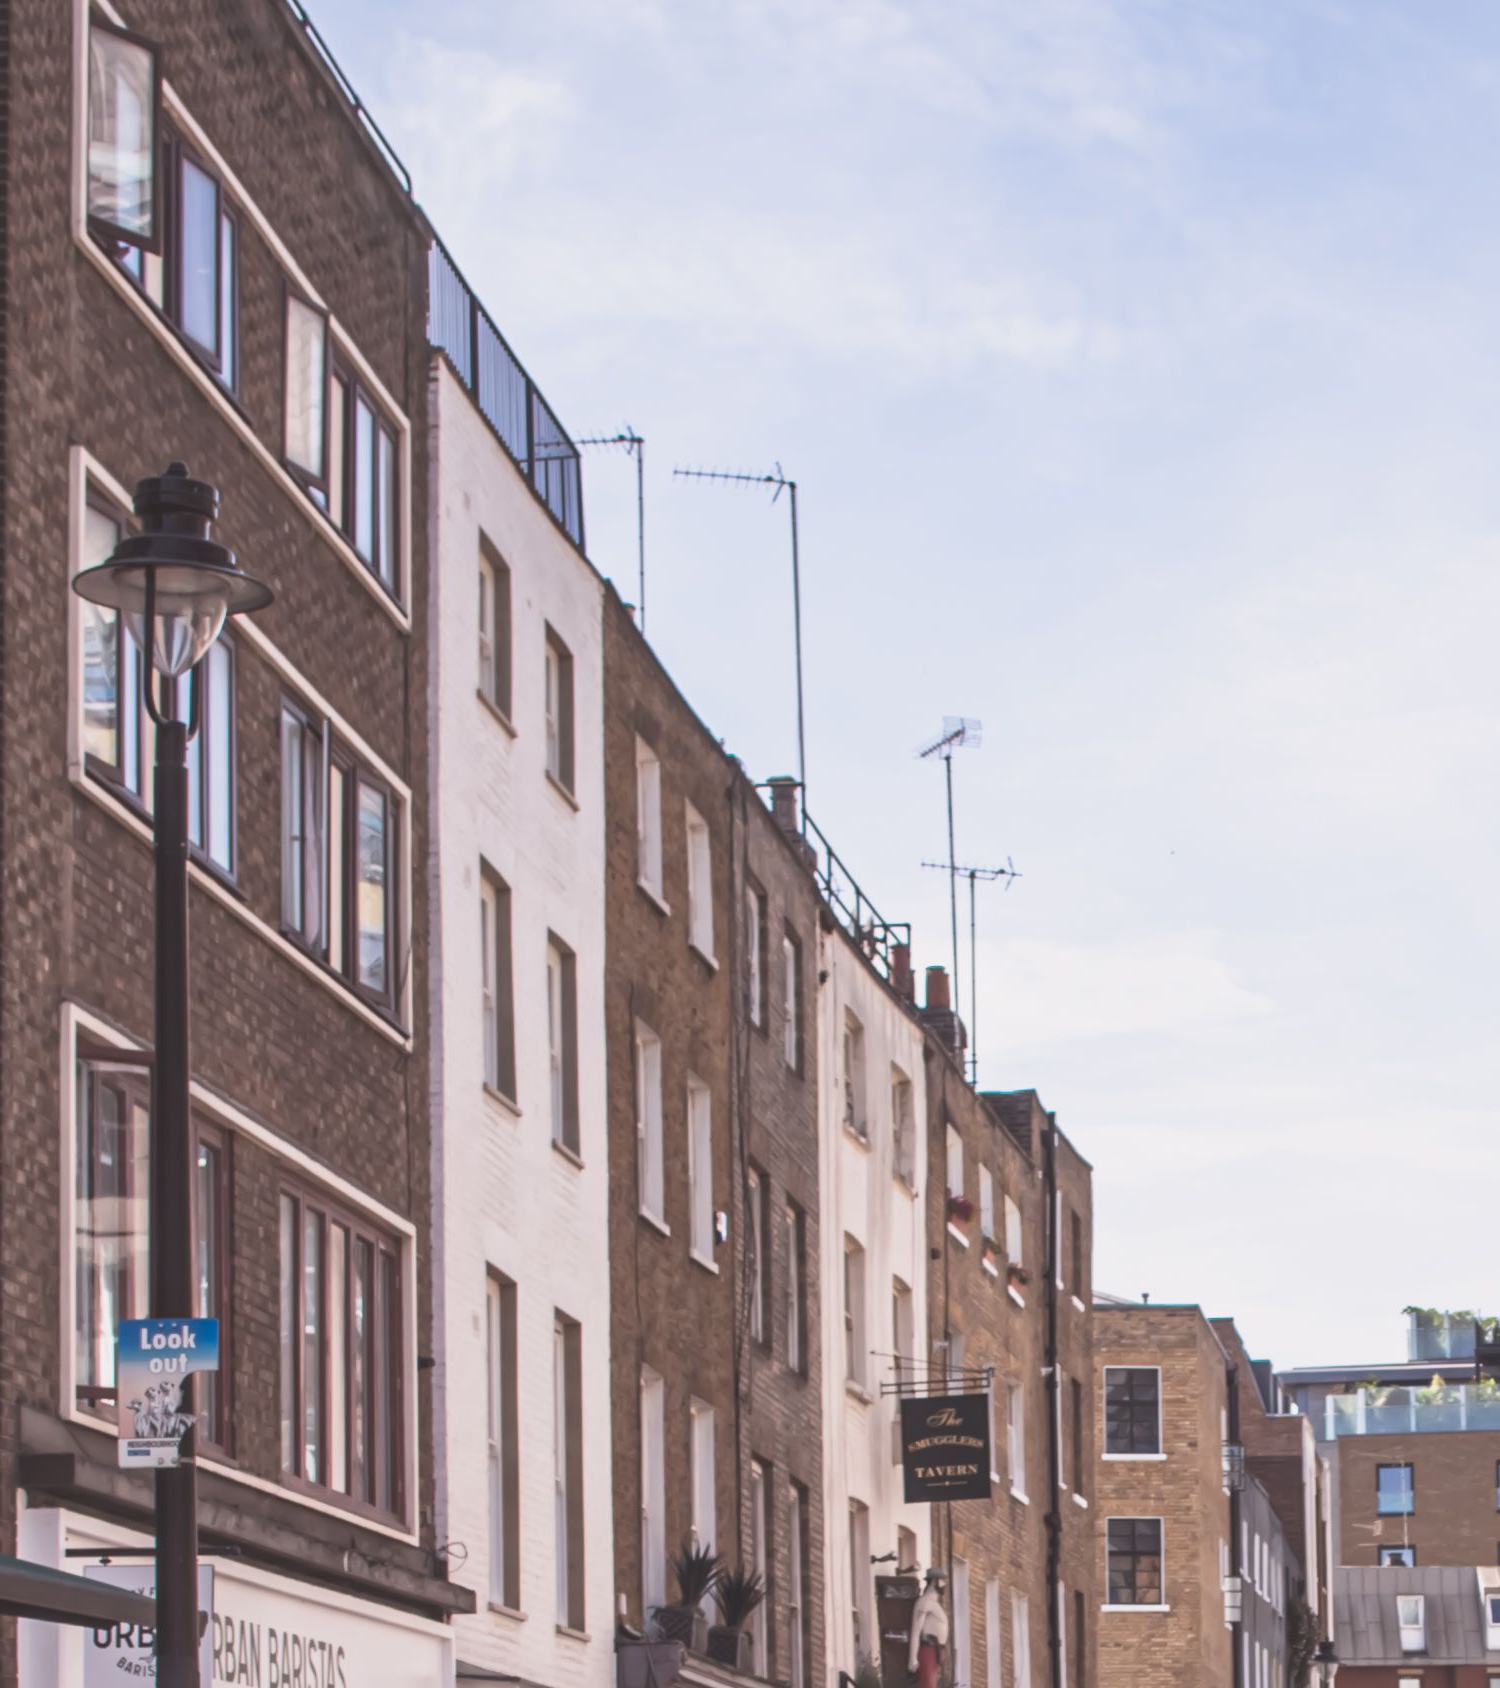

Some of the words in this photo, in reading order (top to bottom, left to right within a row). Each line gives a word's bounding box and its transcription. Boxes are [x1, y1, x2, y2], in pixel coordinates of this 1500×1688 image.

[140, 1325, 196, 1350] Look
[150, 1353, 188, 1373] out
[926, 1408, 964, 1428] The
[915, 1464, 979, 1478] TAVERN
[212, 1612, 261, 1688] RBAN
[117, 1656, 156, 1676] BARIS
